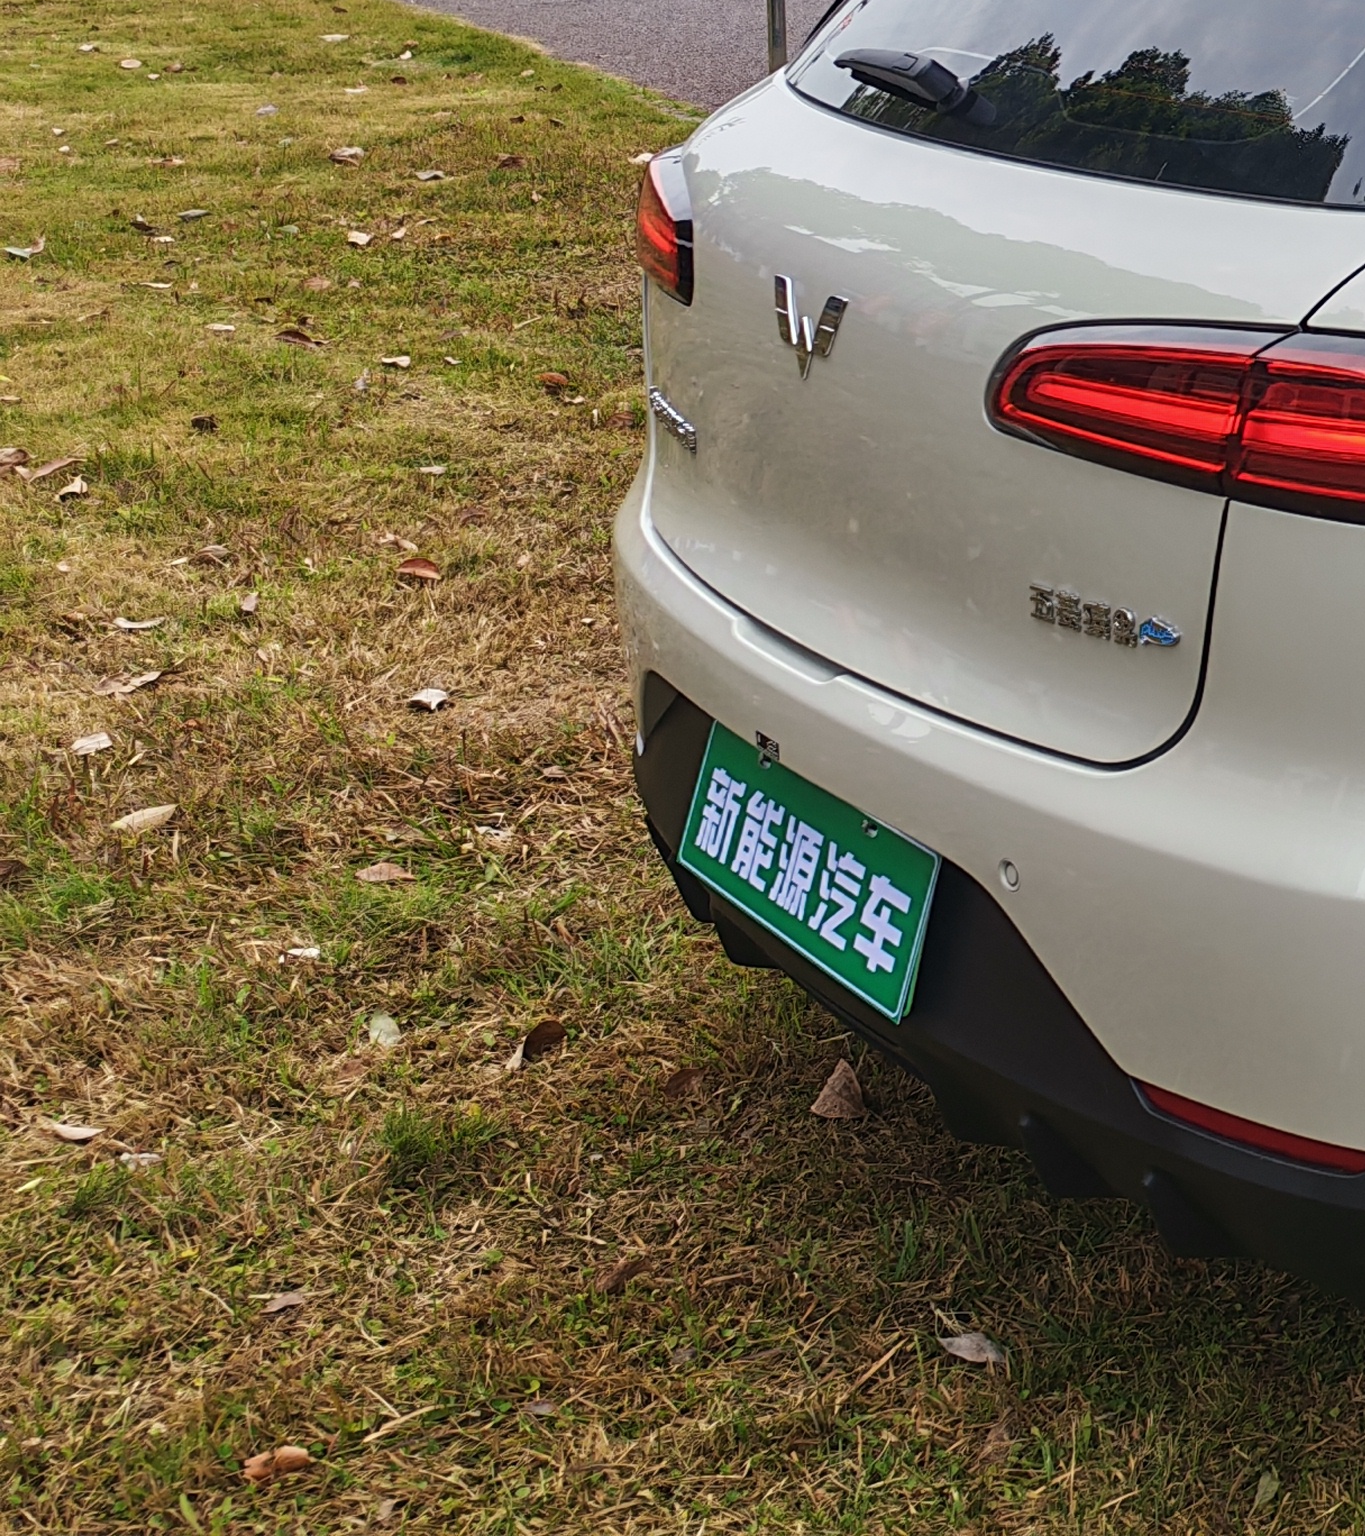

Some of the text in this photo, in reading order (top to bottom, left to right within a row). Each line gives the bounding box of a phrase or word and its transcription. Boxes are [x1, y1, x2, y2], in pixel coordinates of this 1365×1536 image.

[694, 767, 912, 975] 新能源汽车
